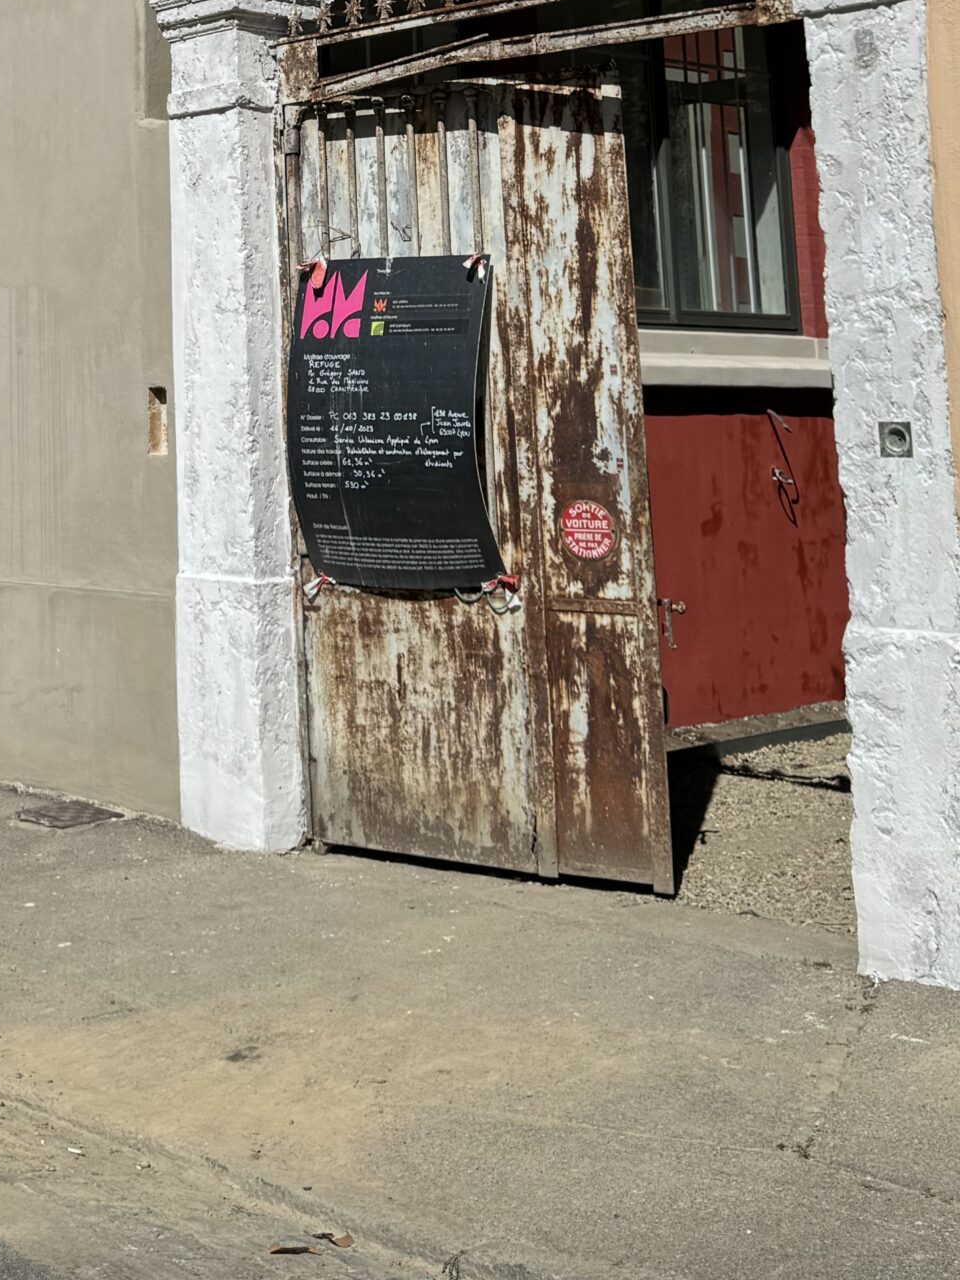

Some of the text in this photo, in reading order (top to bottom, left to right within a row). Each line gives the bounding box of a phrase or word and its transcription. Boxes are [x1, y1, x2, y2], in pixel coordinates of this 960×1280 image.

[309, 360, 341, 368] REFUGE
[435, 418, 451, 426] Jean
[569, 502, 607, 520] SORTIE
[565, 519, 608, 529] VOITURE
[565, 536, 611, 558] STATIONNER
